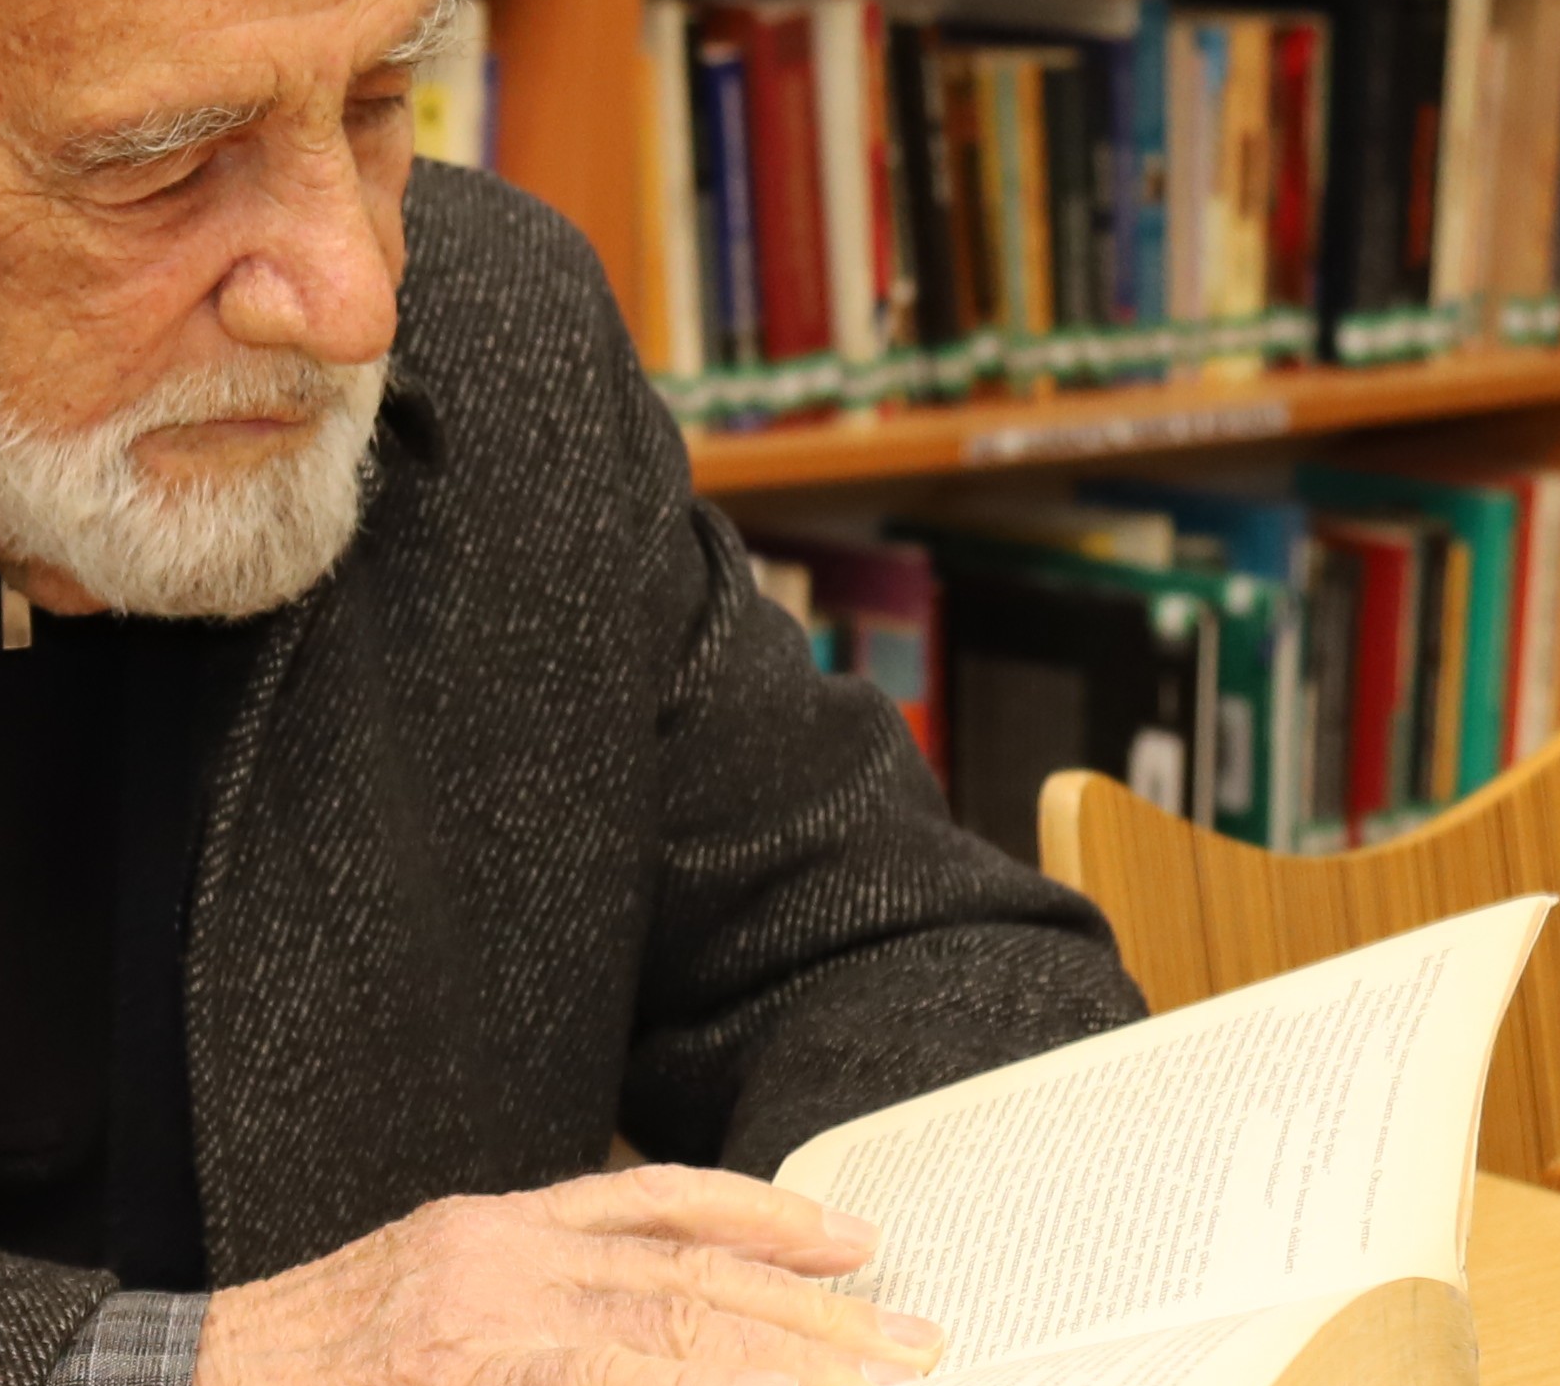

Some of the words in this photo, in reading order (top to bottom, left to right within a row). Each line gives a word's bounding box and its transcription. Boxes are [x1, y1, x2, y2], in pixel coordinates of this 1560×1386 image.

[1309, 1128, 1324, 1145] bir
[1327, 1126, 1341, 1142] de
[1299, 1163, 1313, 1185] gibi
[1362, 1168, 1383, 1215] Oturun,
[1292, 1186, 1310, 1223] burun
[1138, 1228, 1153, 1248] Her
[1359, 1216, 1372, 1254] yeme-
[1054, 1246, 1070, 1267] kaç
[1120, 1245, 1133, 1261] bir
[1283, 1225, 1301, 1275] delikleri
[1067, 1270, 1081, 1287] bu
